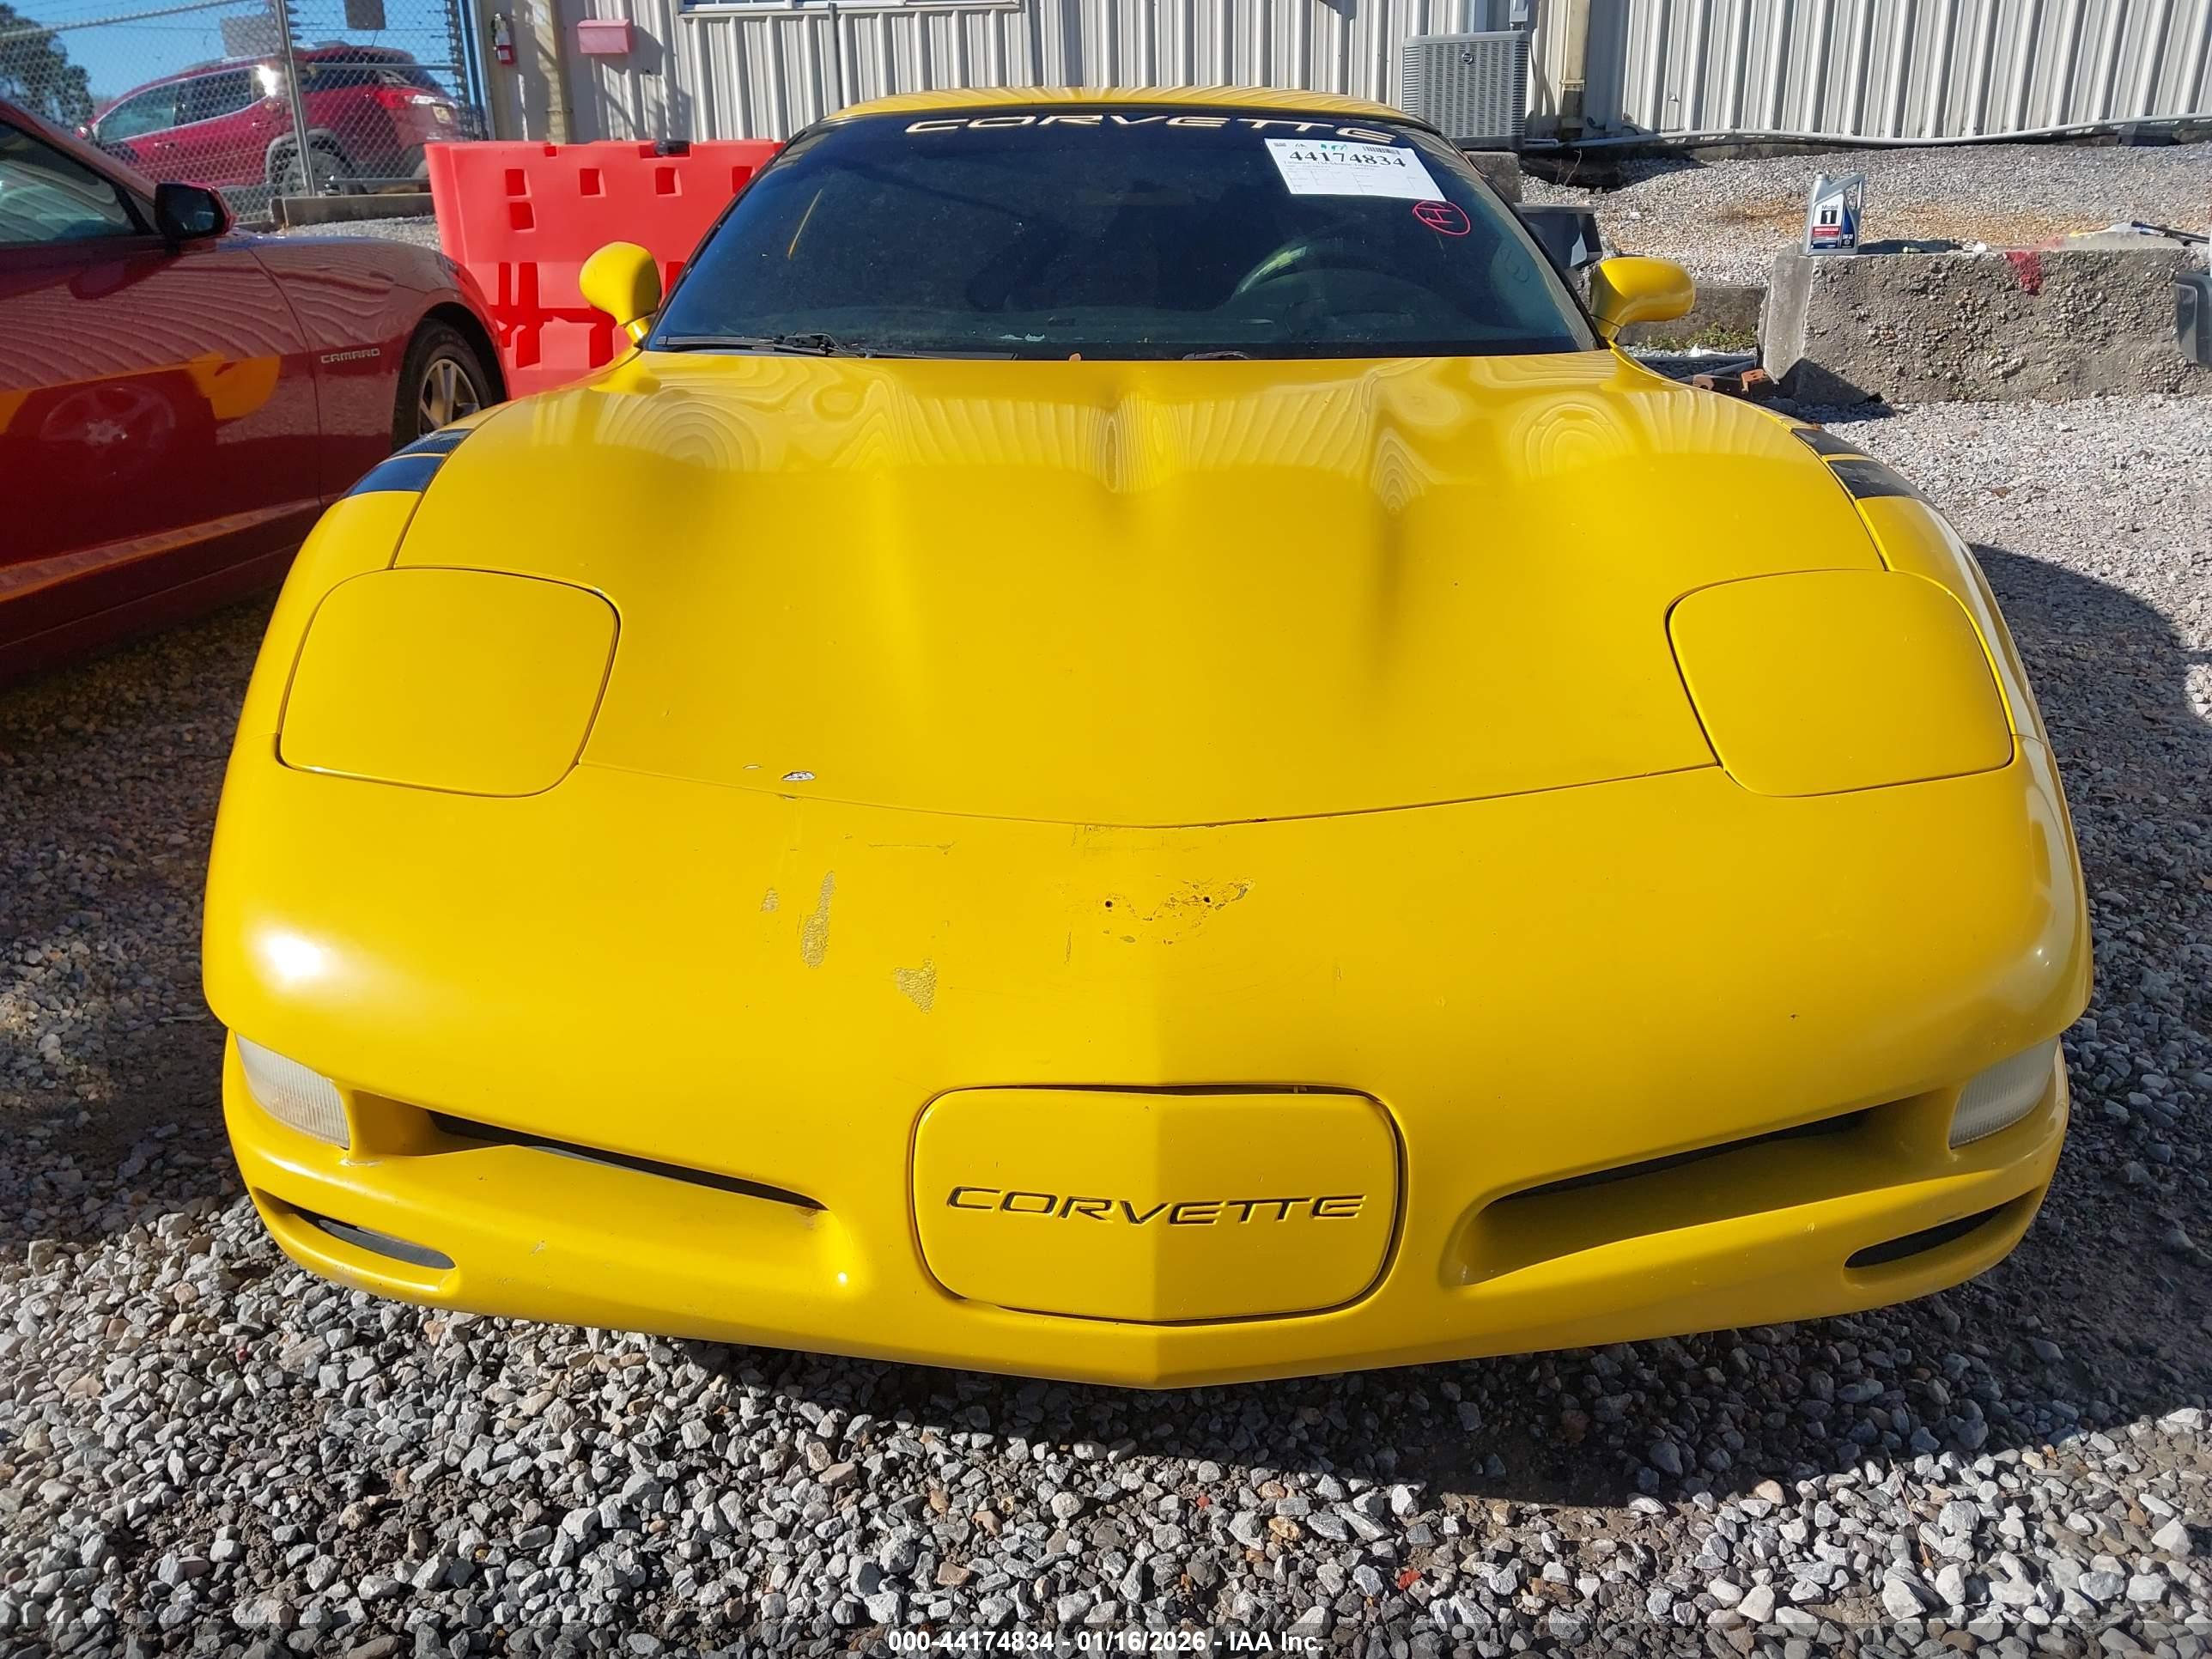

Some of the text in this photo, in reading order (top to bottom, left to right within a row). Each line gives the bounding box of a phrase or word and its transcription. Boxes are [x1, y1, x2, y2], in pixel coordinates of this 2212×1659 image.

[905, 115, 1397, 145] CORVETTE
[1289, 150, 1407, 167] 44174834
[320, 347, 380, 363] CAMARO
[946, 1186, 1367, 1225] CORVETTE
